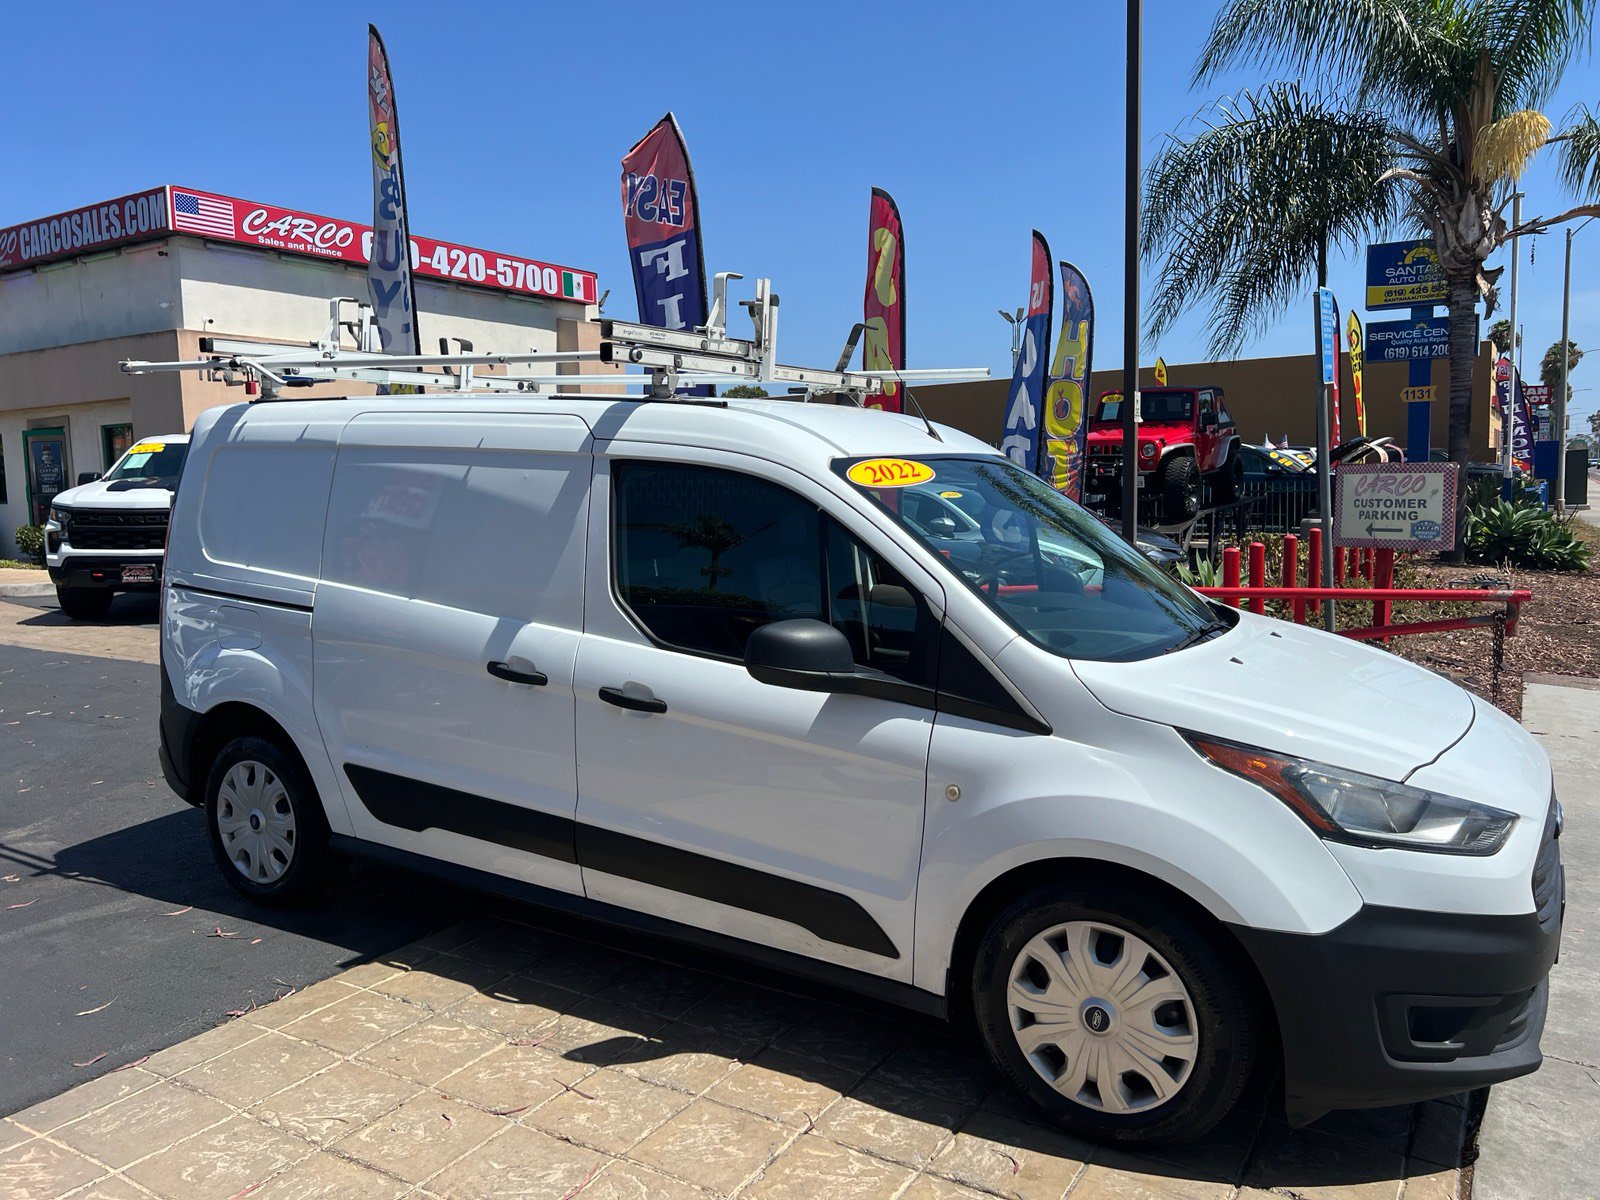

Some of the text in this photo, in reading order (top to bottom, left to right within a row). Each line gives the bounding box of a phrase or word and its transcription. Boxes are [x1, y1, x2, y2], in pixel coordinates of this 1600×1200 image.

[20, 192, 167, 260] CARCOSALES.COM
[242, 209, 354, 248] CARCO
[258, 235, 342, 257] Sales and Finance
[361, 230, 558, 295] 6-420-5700
[1385, 264, 1439, 277] SANTA
[1389, 276, 1416, 284] AUTO
[1384, 288, 1406, 298] (619)
[1369, 328, 1449, 341] SERVICE CEN
[1384, 344, 1450, 359] (619) 614 200
[1404, 389, 1431, 400] 1131
[1523, 387, 1548, 395] AN
[865, 462, 921, 483] 2022
[1354, 474, 1427, 496] CARCO
[1353, 498, 1428, 509] CUSTOMER
[1359, 510, 1419, 521] PARKING
